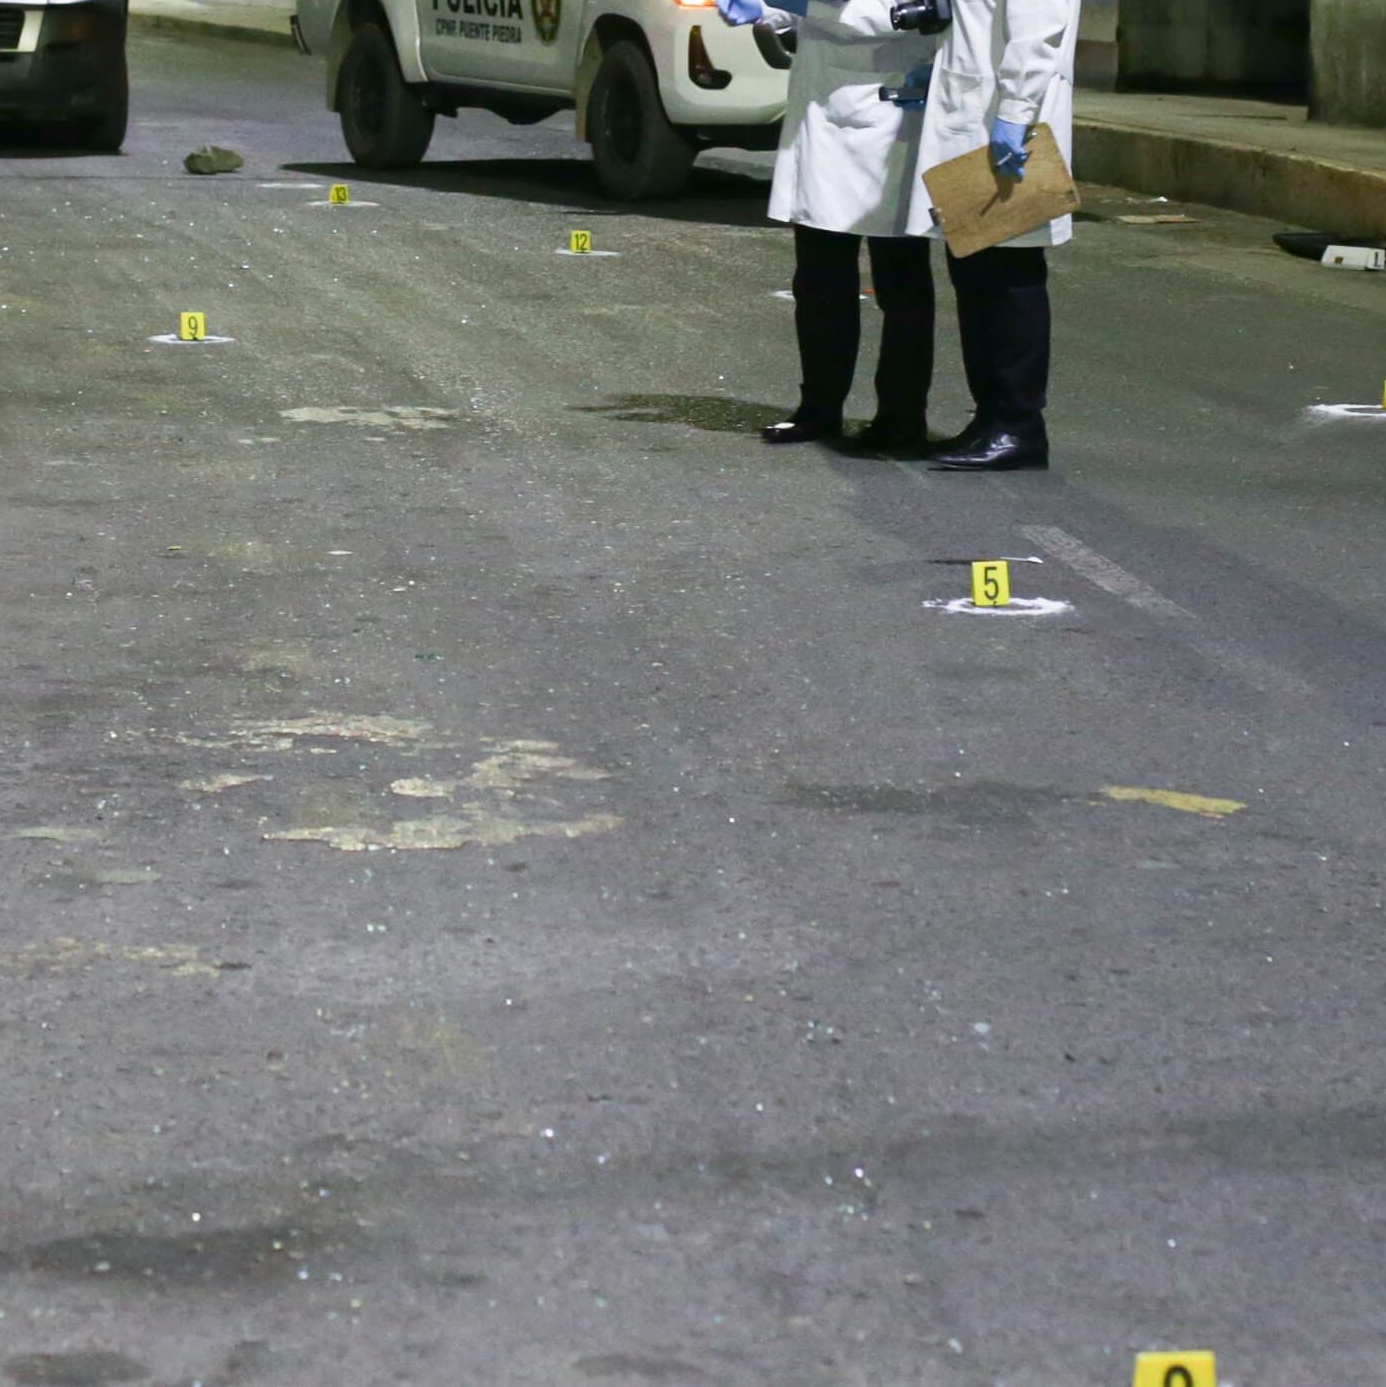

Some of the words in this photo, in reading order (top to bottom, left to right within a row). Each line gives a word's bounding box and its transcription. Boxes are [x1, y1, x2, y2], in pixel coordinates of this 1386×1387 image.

[334, 185, 348, 202] 13
[574, 233, 589, 251] 12
[187, 315, 199, 336] 9
[983, 565, 1000, 601] 5
